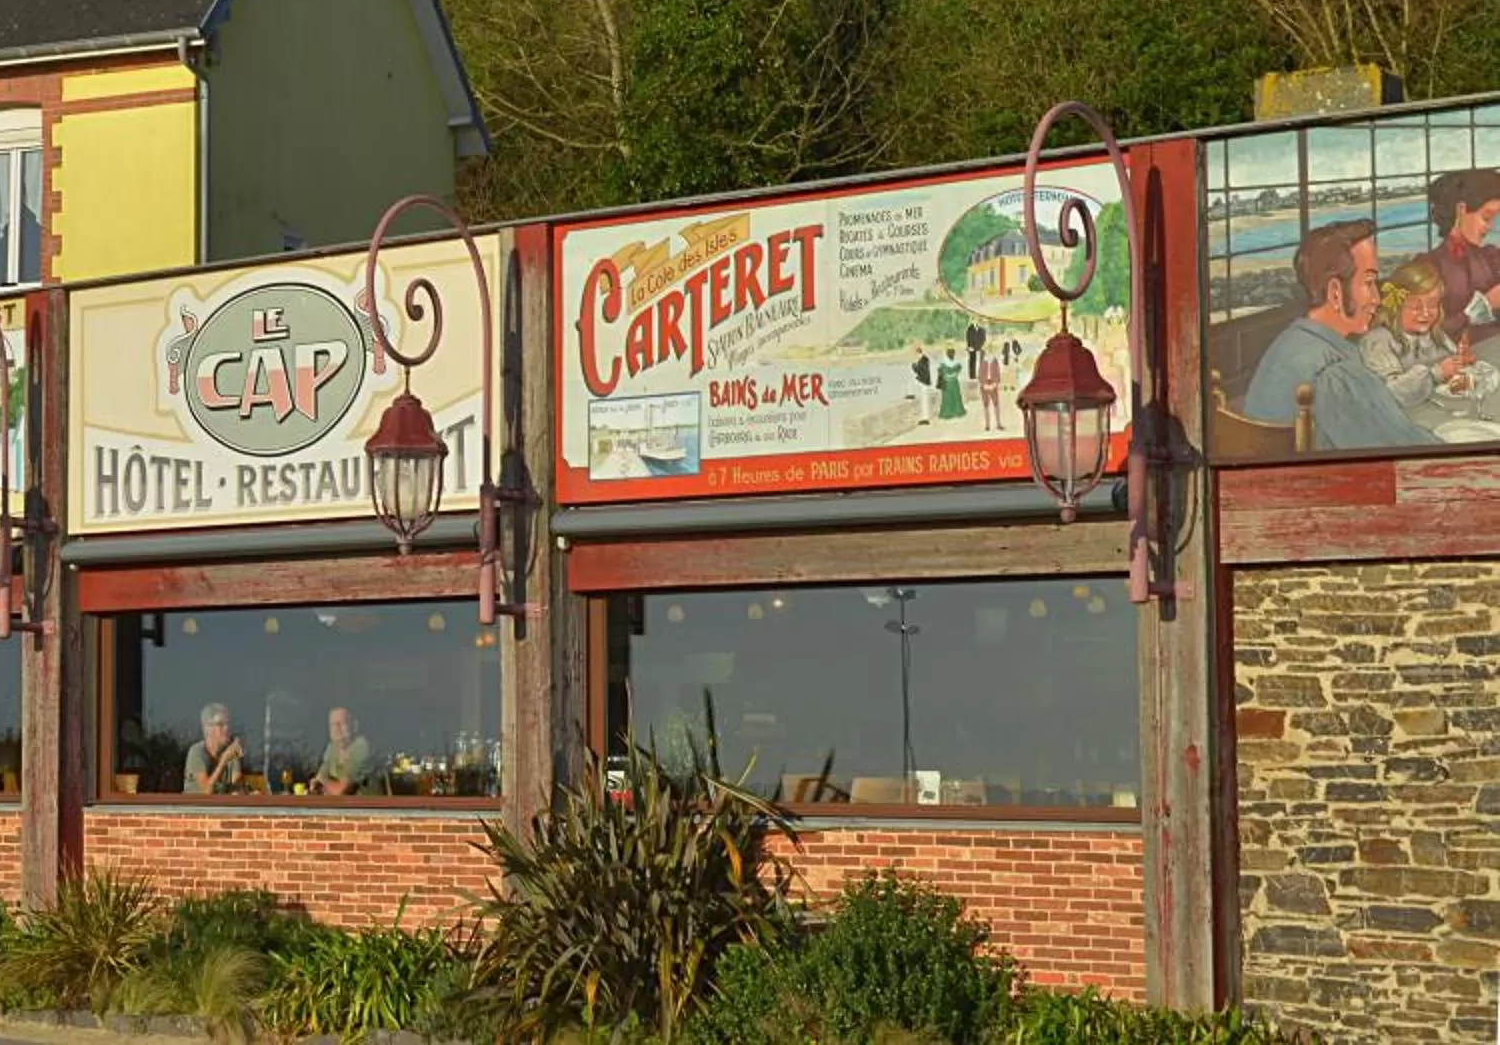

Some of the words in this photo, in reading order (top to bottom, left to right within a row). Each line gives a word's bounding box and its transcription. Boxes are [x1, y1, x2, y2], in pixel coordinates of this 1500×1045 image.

[678, 250, 701, 273] des
[705, 228, 738, 258] Isles
[251, 306, 290, 343] LE
[575, 224, 824, 398] CARTERET
[197, 339, 348, 424] CAP
[708, 375, 758, 411] BAINS
[761, 385, 777, 404] de
[779, 372, 830, 407] MER
[94, 444, 213, 520] HÔTEL
[236, 415, 476, 507] RESTAUT
[720, 466, 728, 486] 7
[731, 465, 780, 485] Heures
[784, 465, 805, 482] de
[811, 459, 850, 481] PARIS
[853, 463, 874, 482] par
[878, 456, 924, 476] TRAINS
[929, 450, 991, 474] RAPIDES
